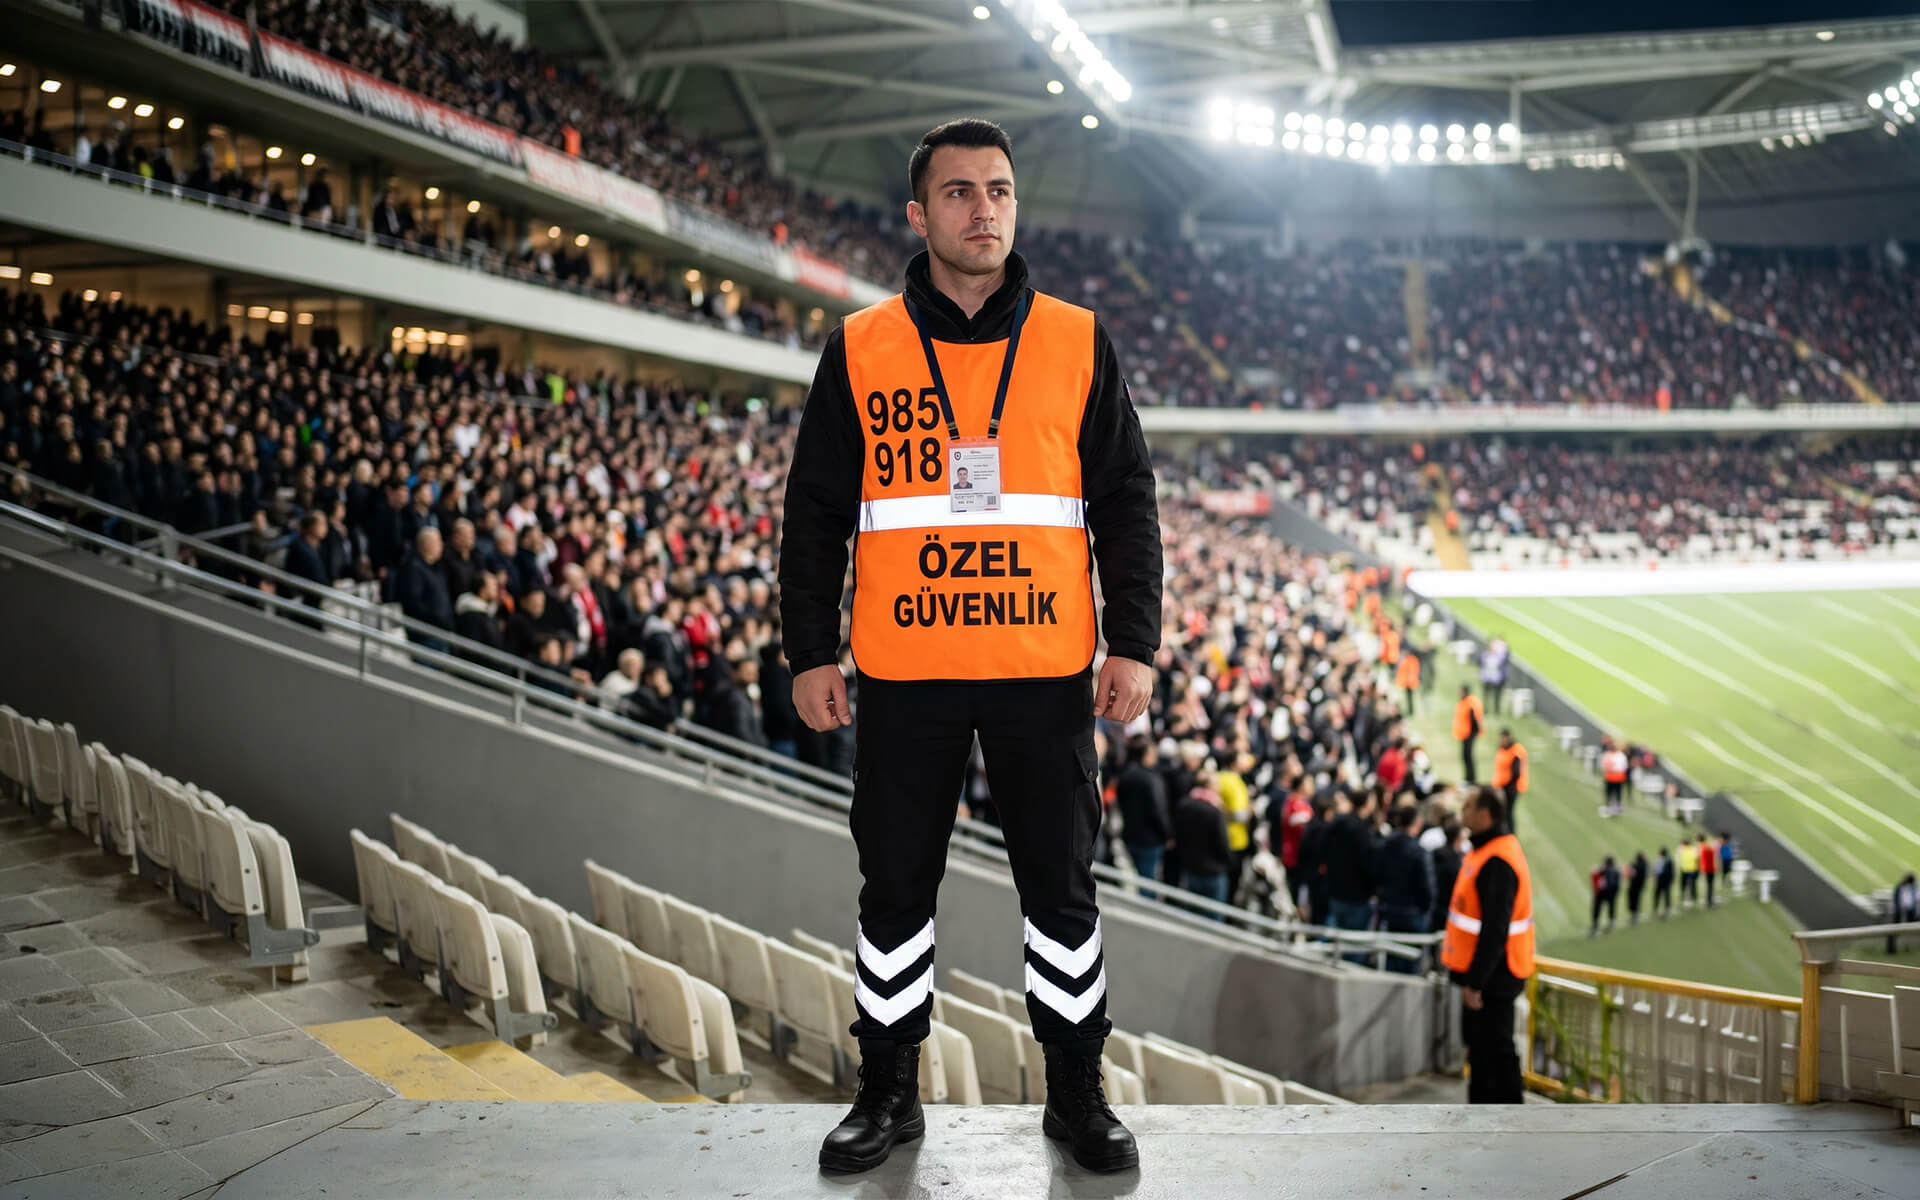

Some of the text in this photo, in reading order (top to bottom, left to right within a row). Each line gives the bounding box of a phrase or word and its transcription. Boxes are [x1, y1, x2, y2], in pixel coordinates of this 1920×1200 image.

[867, 387, 941, 436] 985
[875, 437, 943, 487] 918
[919, 534, 1032, 578] ÖZEL
[894, 583, 1058, 628] GÜVENLİK
